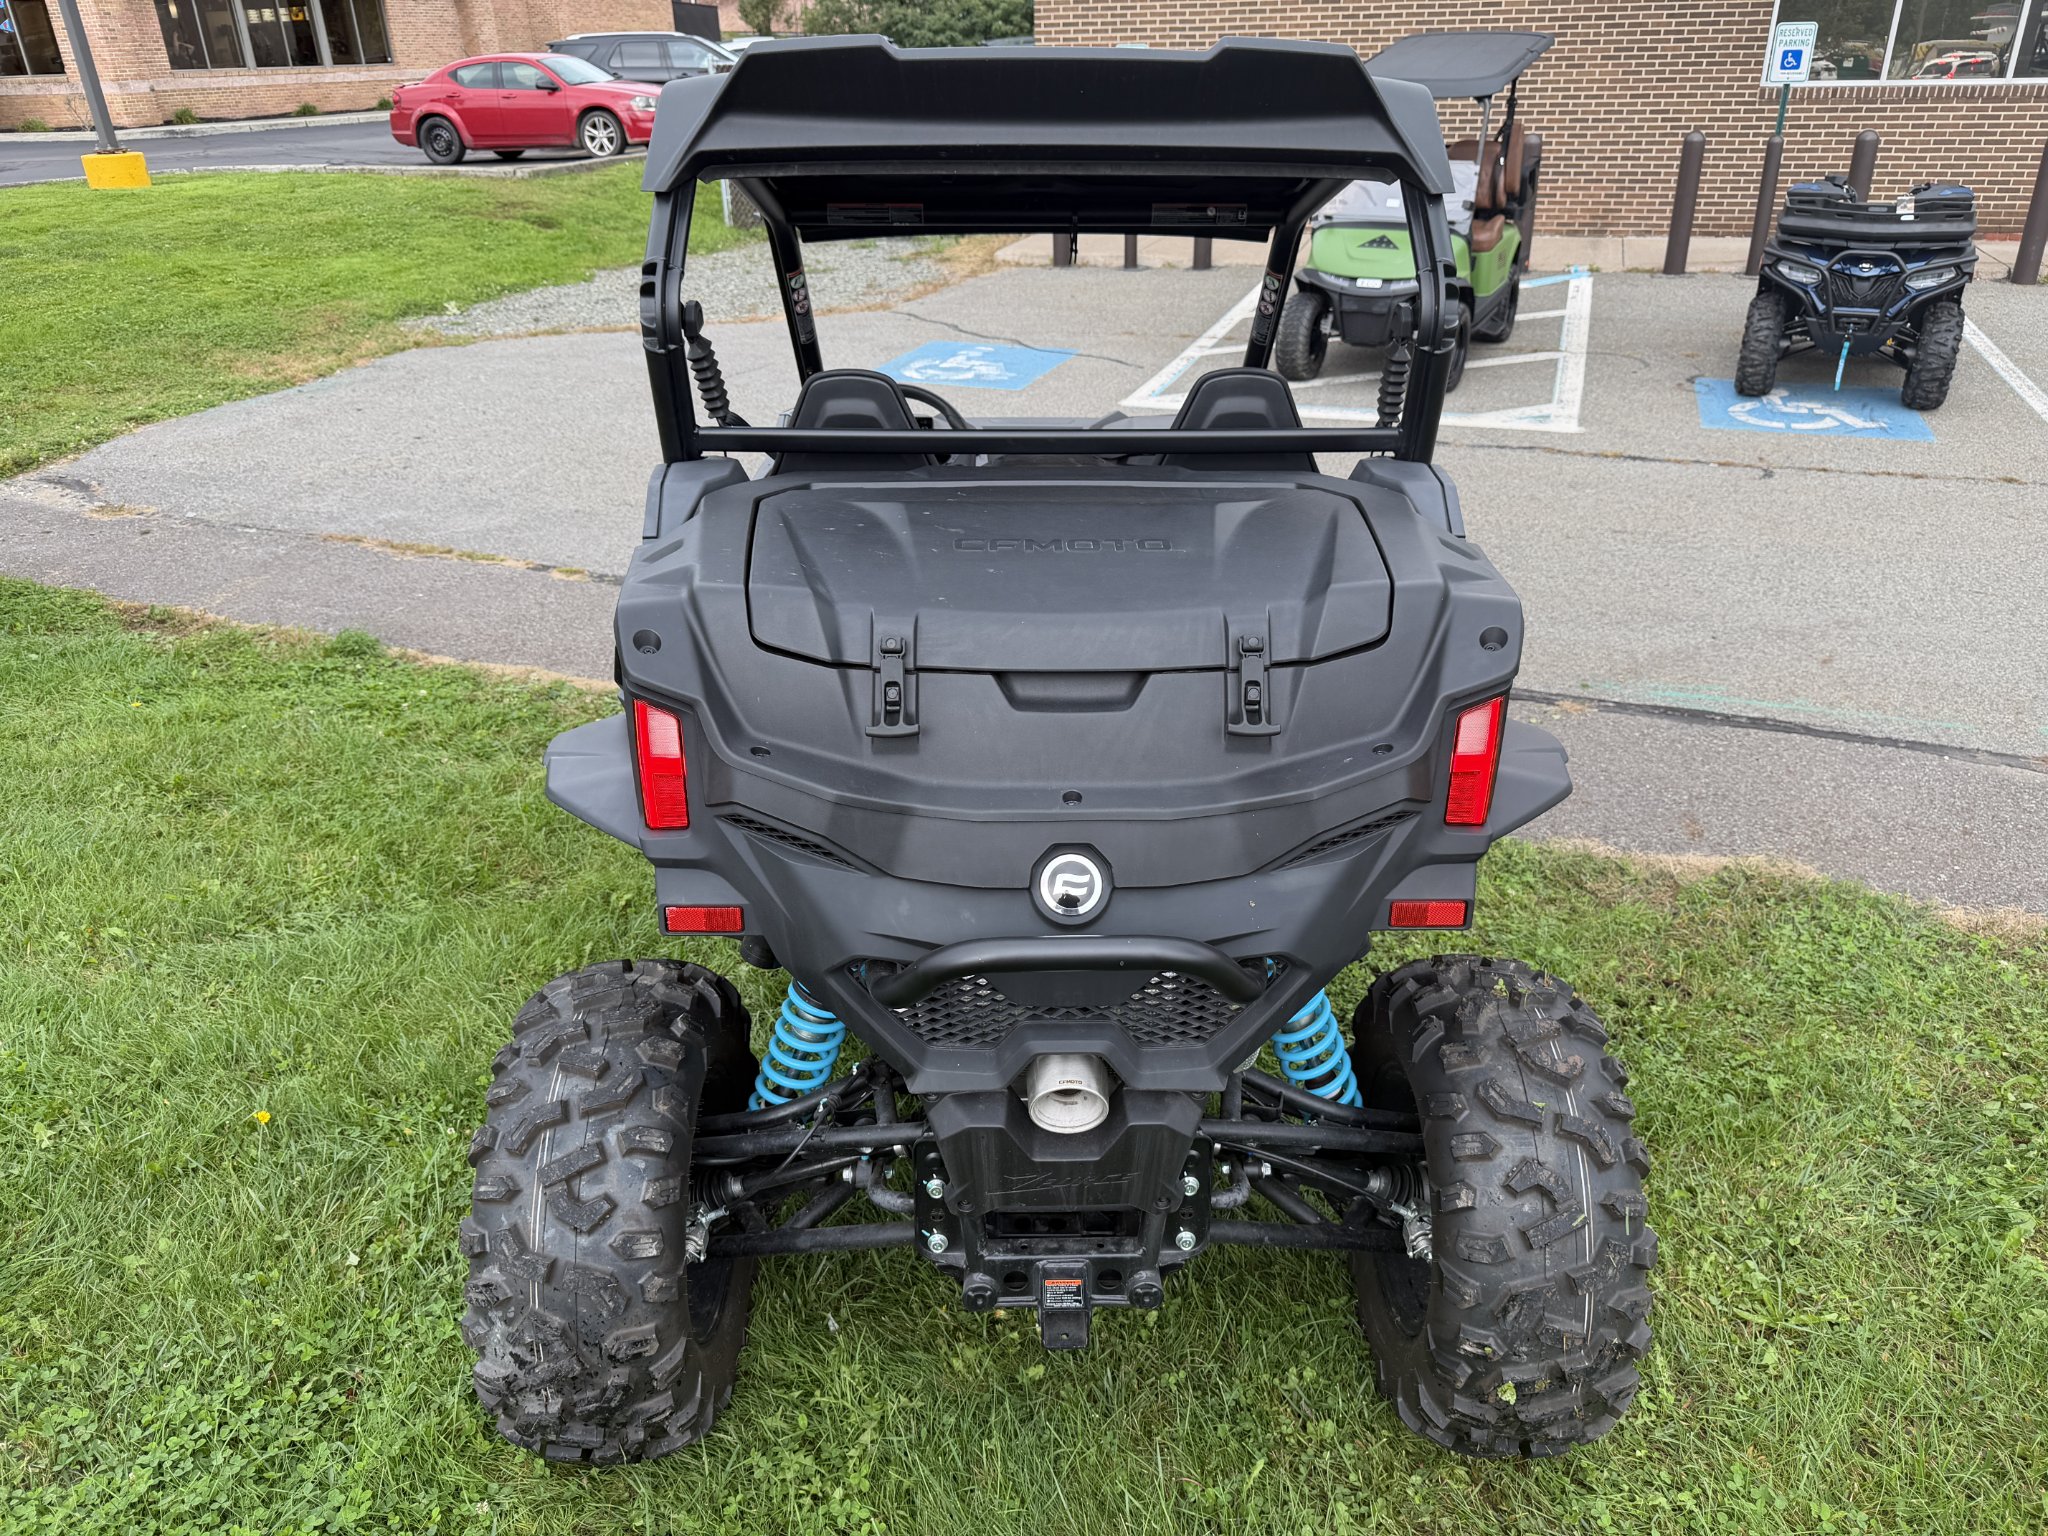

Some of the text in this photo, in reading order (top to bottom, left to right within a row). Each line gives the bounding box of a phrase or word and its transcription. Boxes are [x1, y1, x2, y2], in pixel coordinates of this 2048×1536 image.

[1778, 28, 1814, 38] RESERVED
[1778, 39, 1811, 48] PARKING
[952, 538, 1173, 552] CFMOTO
